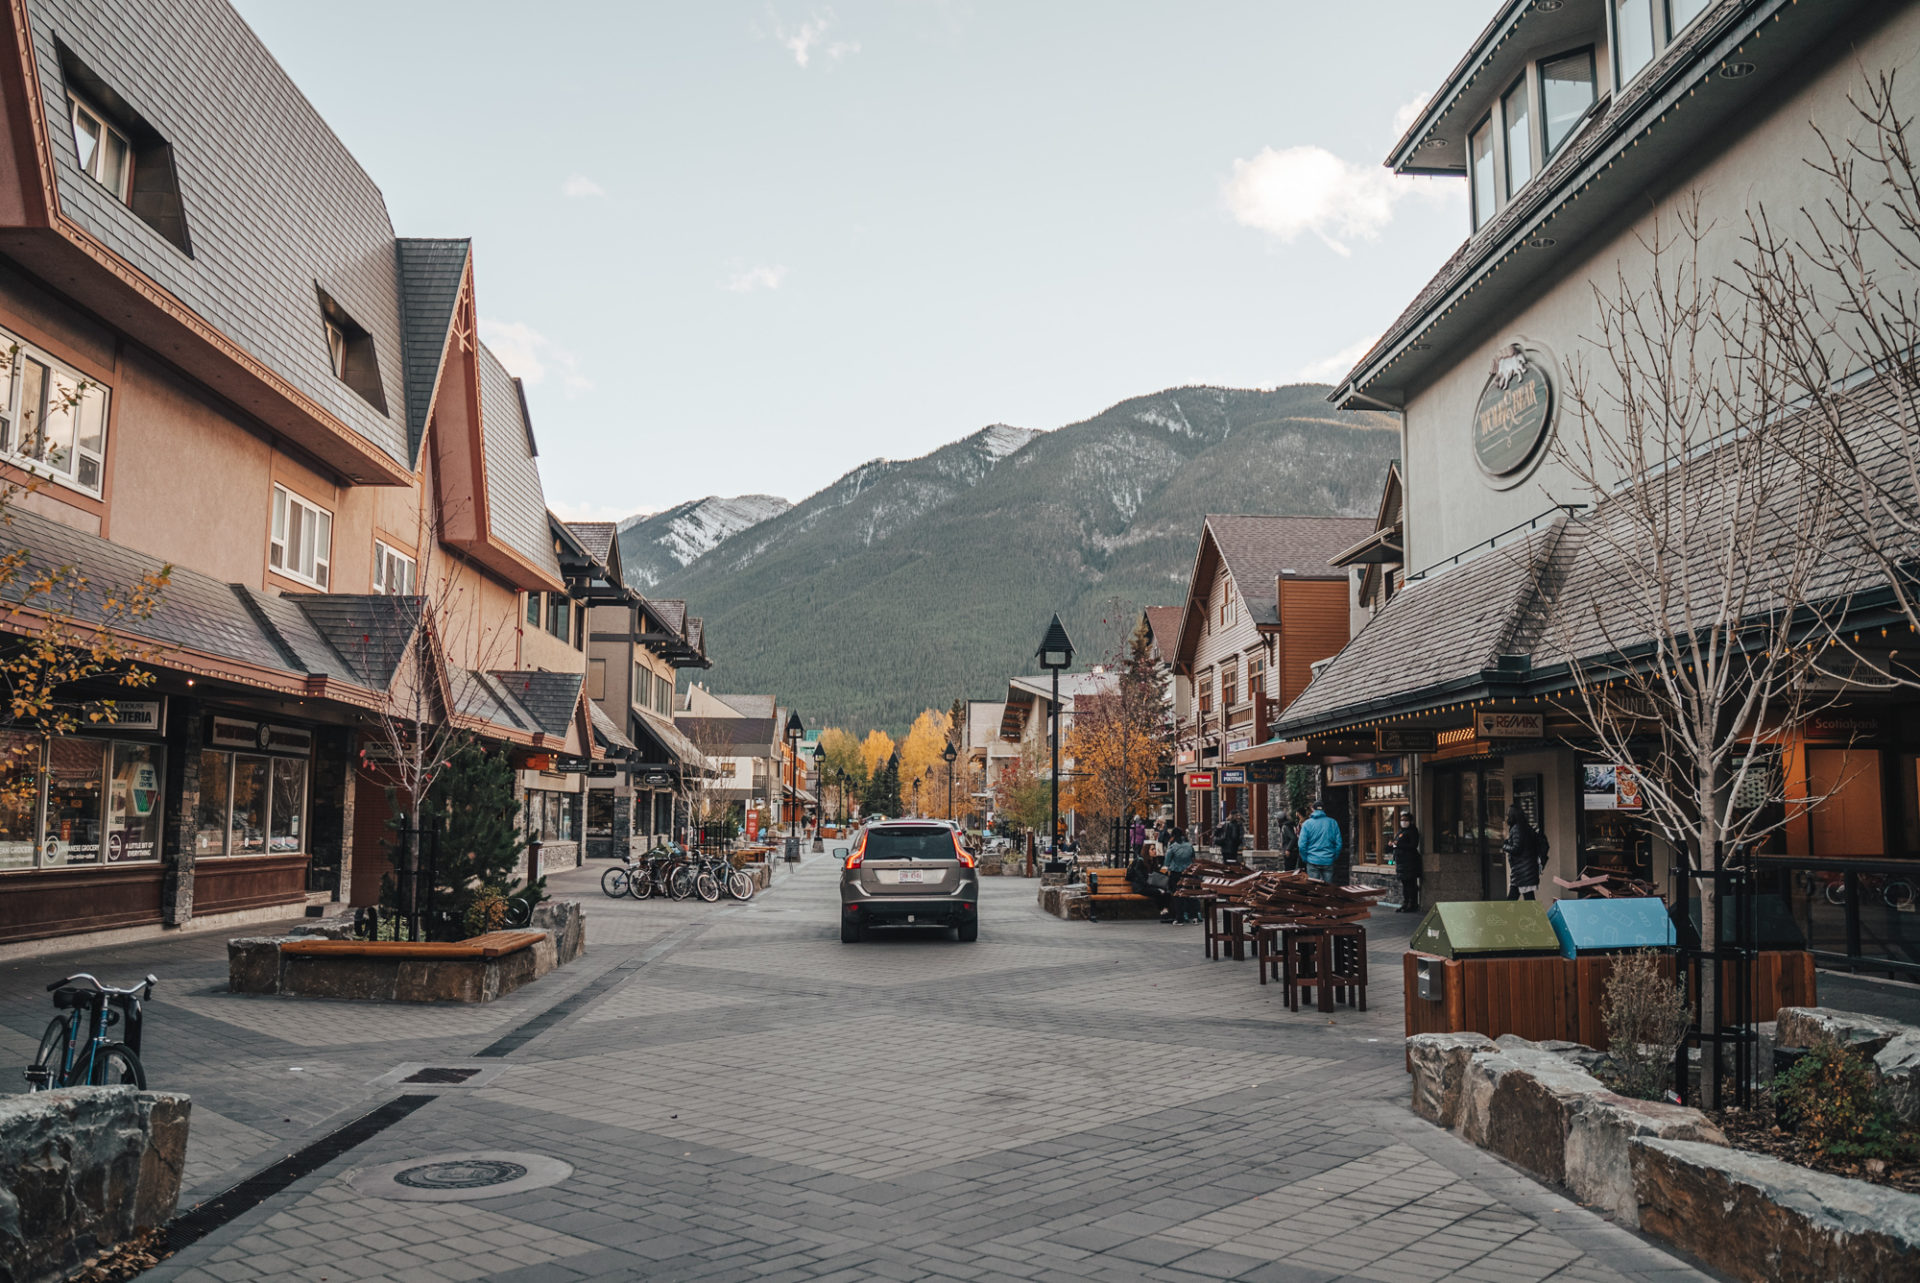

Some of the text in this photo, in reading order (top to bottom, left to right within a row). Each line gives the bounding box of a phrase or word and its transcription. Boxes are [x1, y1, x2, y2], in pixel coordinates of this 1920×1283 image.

[1512, 380, 1538, 416] BEAR
[1496, 715, 1539, 728] RE/MAX
[1815, 717, 1879, 729] Scotiabank
